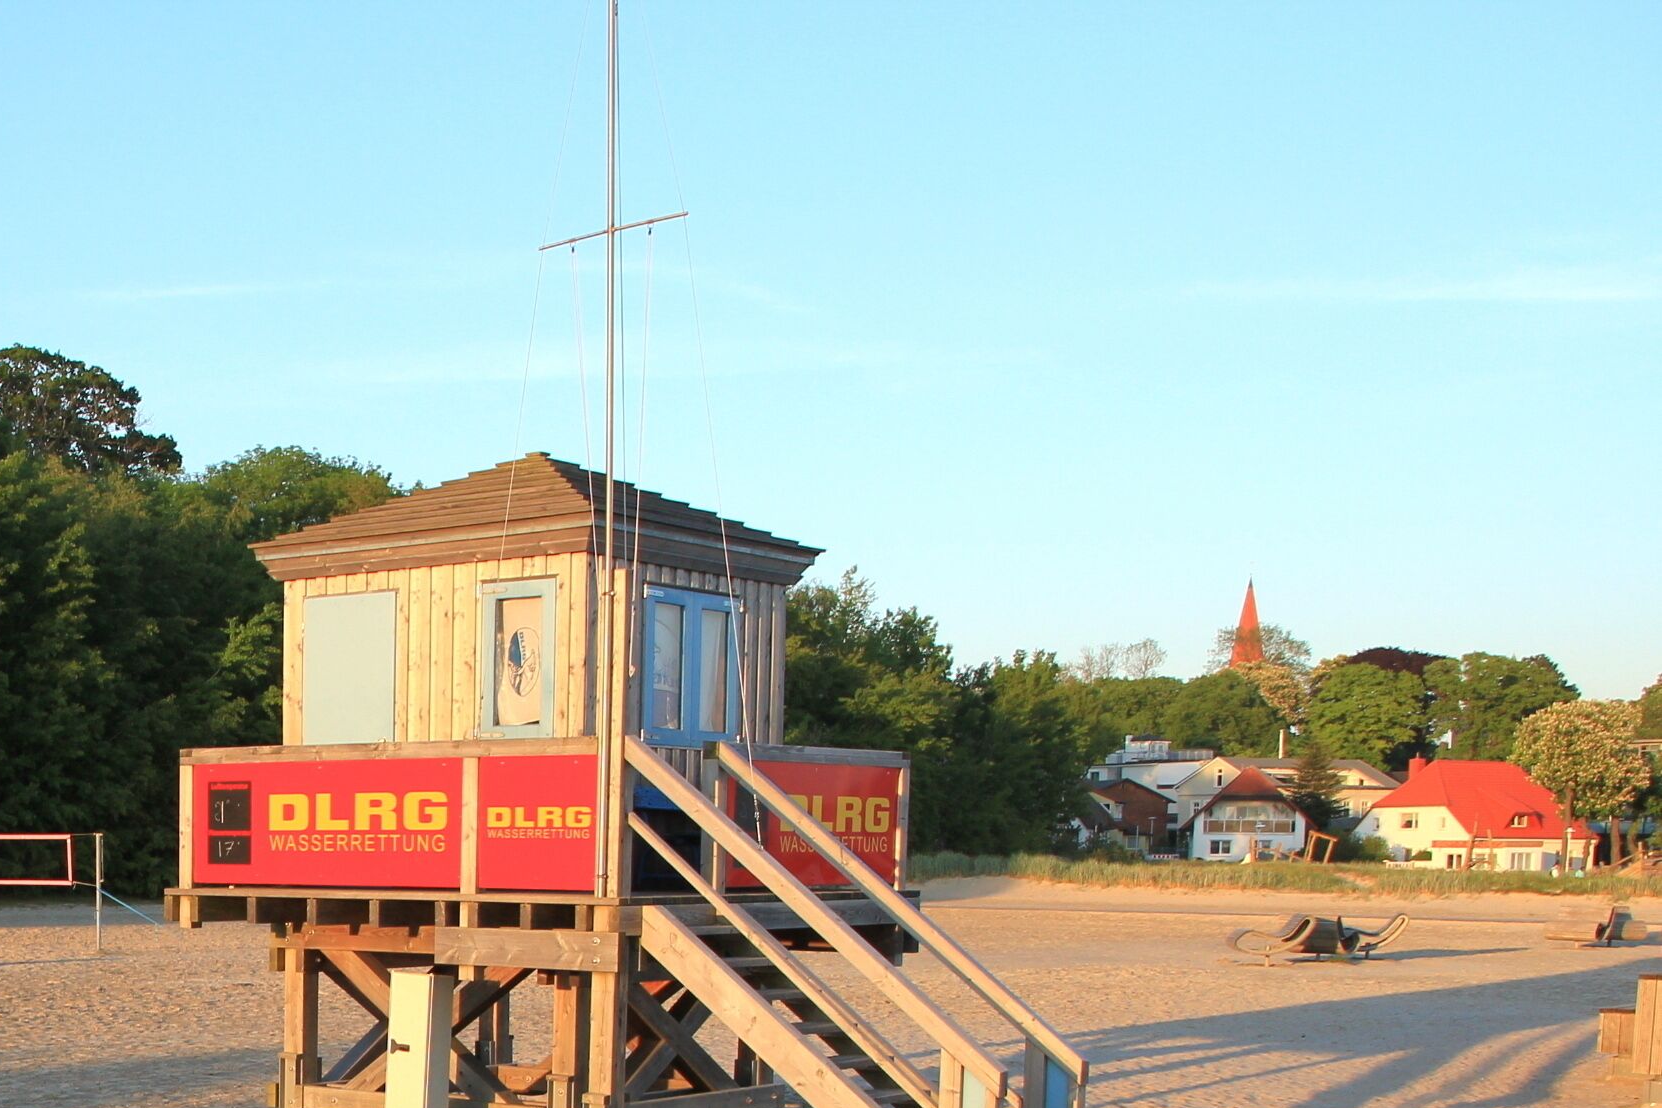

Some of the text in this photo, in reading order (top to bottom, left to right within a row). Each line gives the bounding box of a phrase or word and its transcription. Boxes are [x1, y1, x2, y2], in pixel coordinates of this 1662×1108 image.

[269, 791, 448, 831] DLRG
[487, 806, 592, 828] DLRG
[269, 834, 446, 852] WASSERRETTUNG
[487, 828, 591, 839] WASSERRETTUNG
